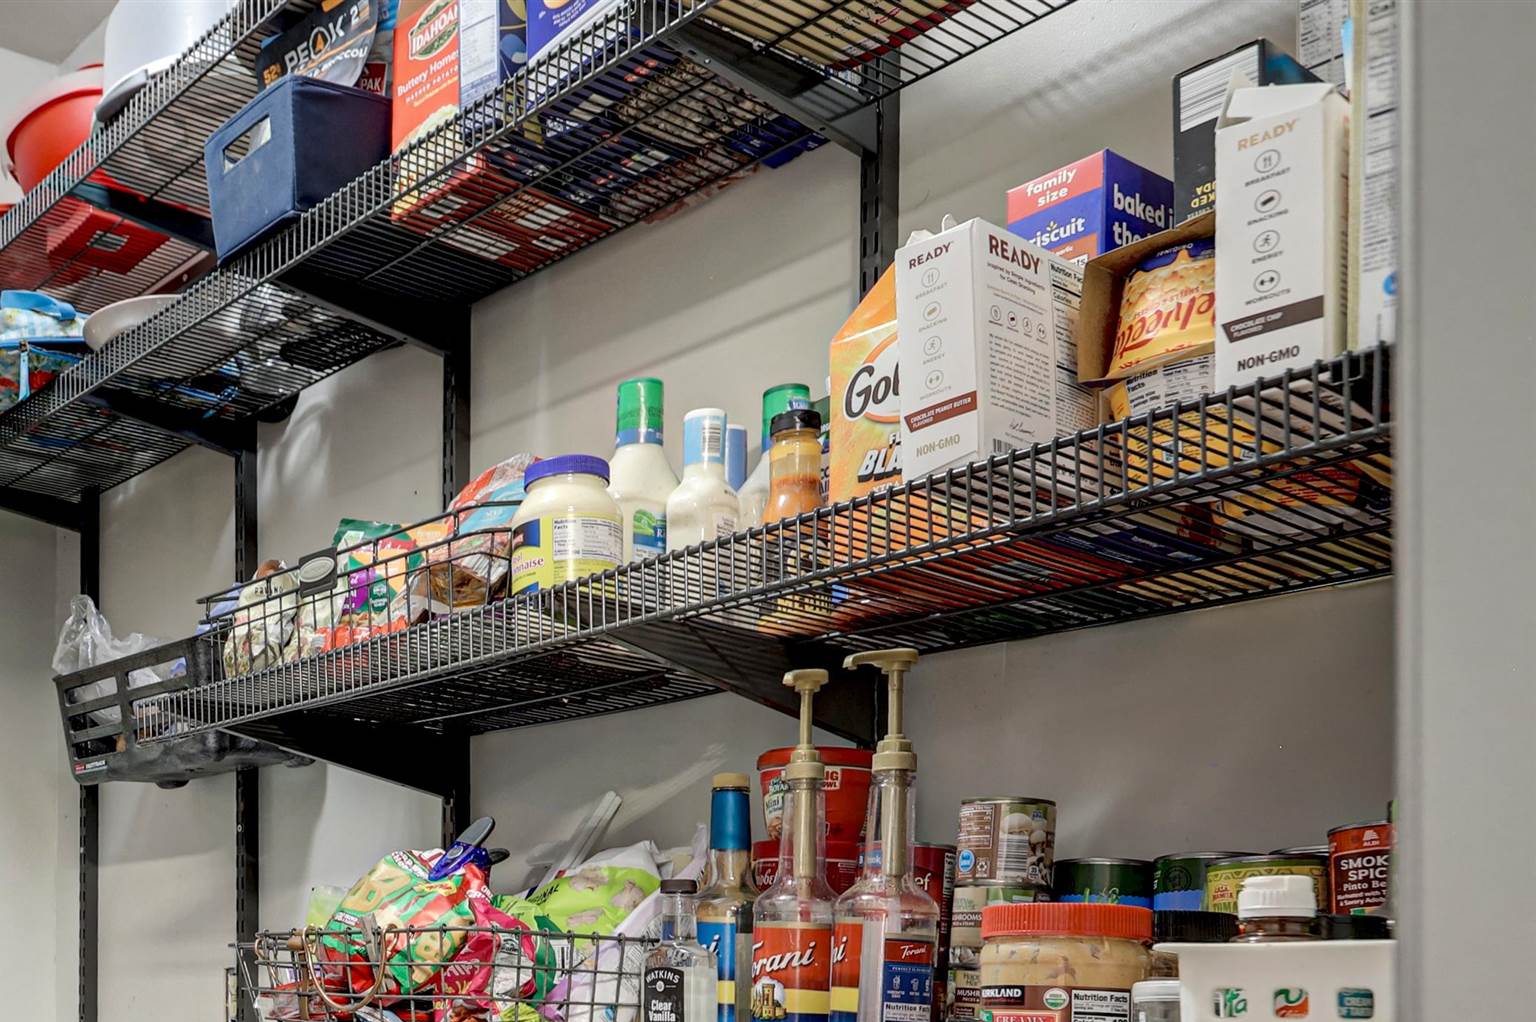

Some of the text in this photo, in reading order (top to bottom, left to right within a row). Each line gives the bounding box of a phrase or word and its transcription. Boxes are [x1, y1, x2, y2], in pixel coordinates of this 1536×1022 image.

[397, 69, 428, 97] Buttery
[1238, 119, 1298, 152] READY
[1026, 167, 1078, 198] family
[1244, 167, 1292, 188] BREAKFAST
[1037, 186, 1069, 208] size
[1113, 183, 1164, 228] baked
[1247, 208, 1290, 227] SNACKING
[909, 241, 951, 270] READY
[988, 233, 1041, 275] READY
[1251, 250, 1284, 265] ENERGY
[1050, 263, 1073, 280] Nutrition
[1244, 288, 1292, 306] WORKOUTS
[1237, 345, 1300, 372] NON-GMO
[1125, 368, 1159, 386] Nutrition
[1126, 382, 1146, 394] Facts
[910, 408, 936, 424] CHOCOLATE
[935, 401, 953, 416] PEANUT
[916, 433, 961, 458] NON-GMO
[1340, 854, 1390, 871] SMOK
[1348, 867, 1388, 881] SPIC
[1343, 882, 1369, 891] Pinto
[900, 943, 927, 960] Torani
[645, 969, 681, 984] WATKINS
[651, 999, 672, 1012] Clear
[885, 1003, 917, 1012] Nutrition
[1073, 993, 1128, 1004] Nutrition Facts
[648, 1010, 676, 1022] Vanilla
